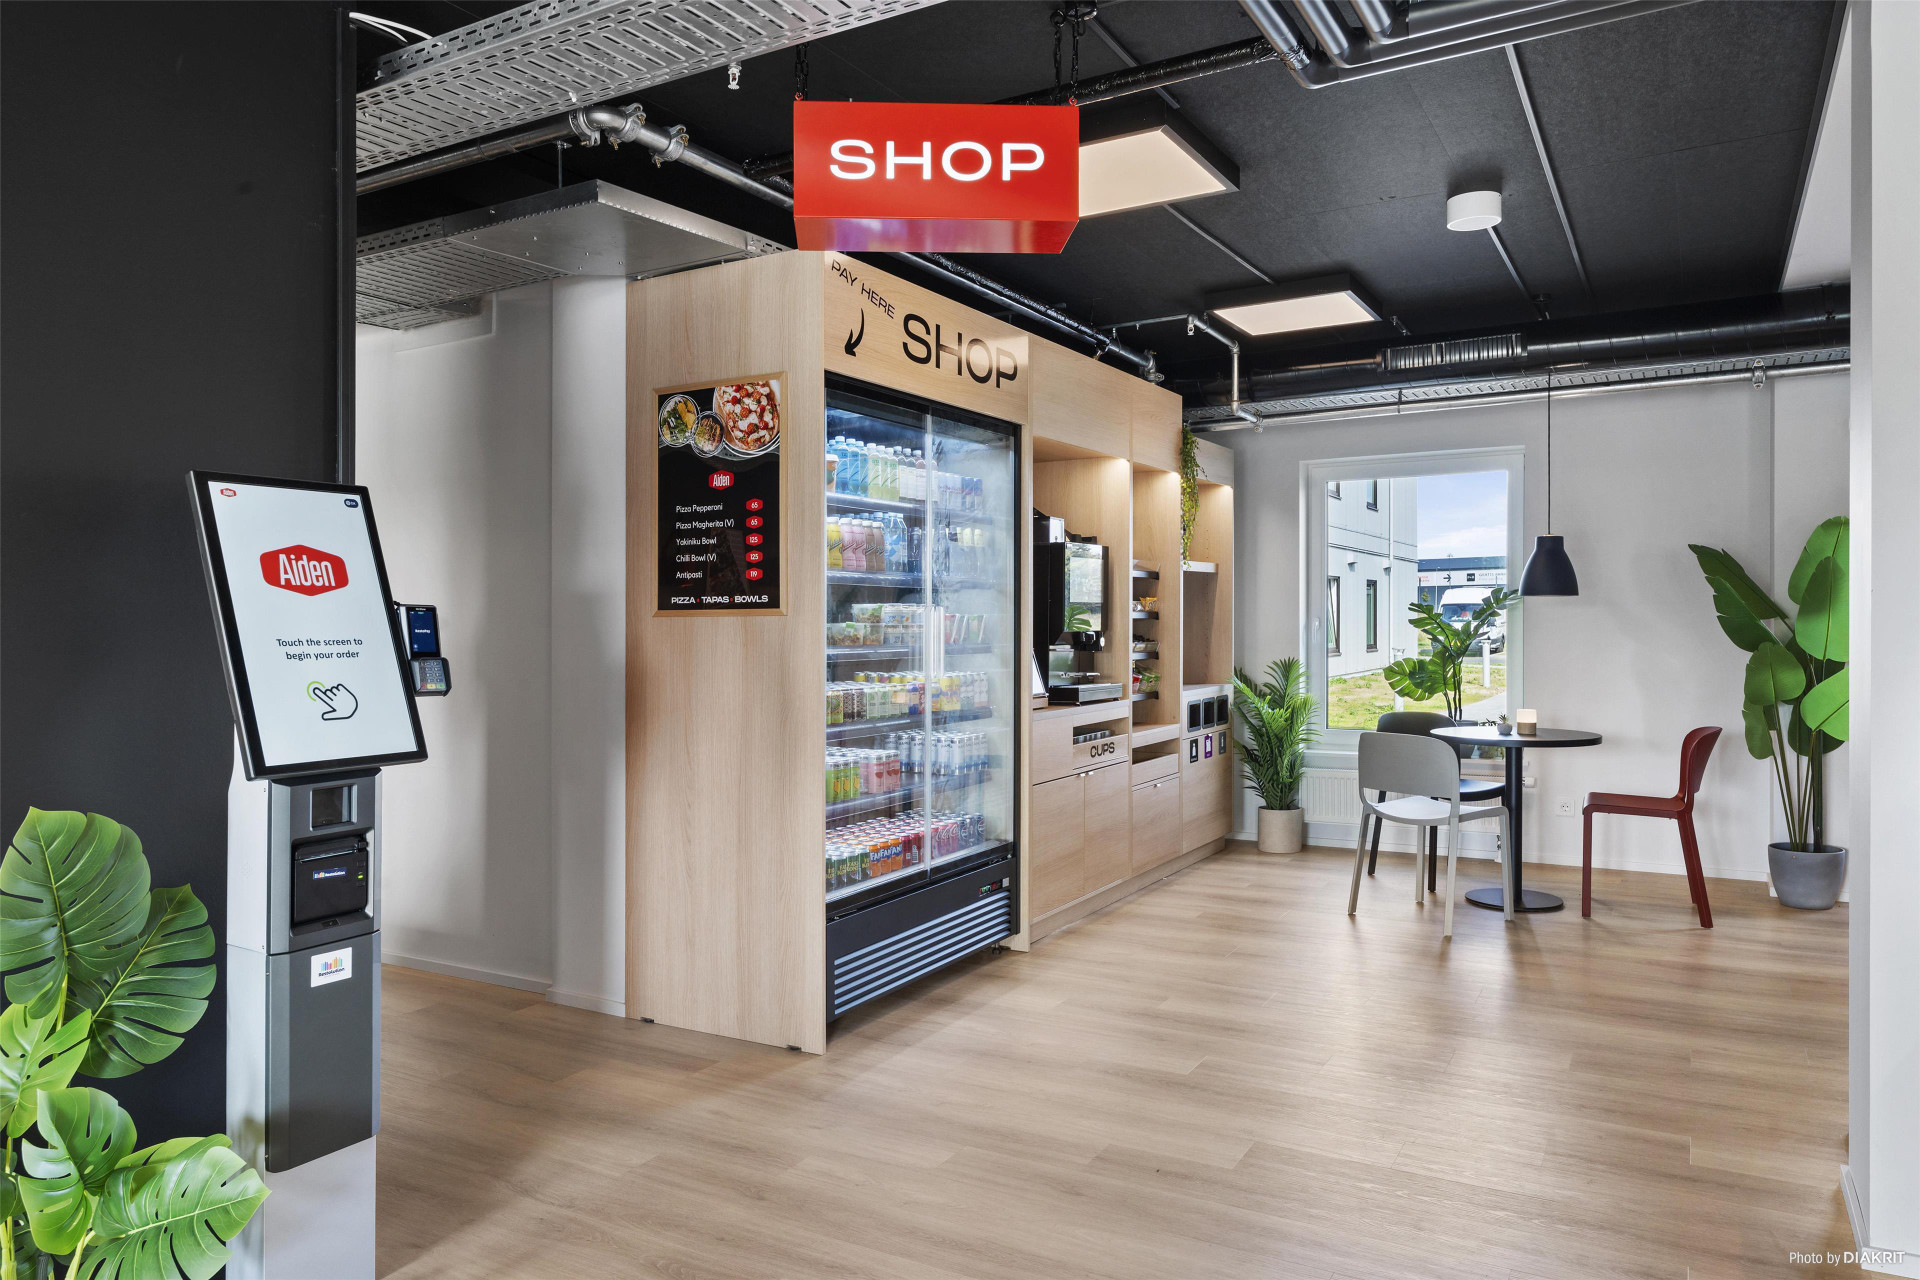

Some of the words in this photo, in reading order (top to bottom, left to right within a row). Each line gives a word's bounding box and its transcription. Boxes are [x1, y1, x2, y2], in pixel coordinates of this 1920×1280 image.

[829, 138, 1045, 182] SHOP
[831, 258, 858, 287] PAY
[861, 282, 896, 319] HERE
[902, 313, 1018, 389] SHOP
[713, 474, 730, 487] Aiden
[676, 505, 691, 513] Pizza
[692, 503, 723, 513] Pepperoni
[751, 501, 758, 509] 65
[676, 522, 691, 530] Pizza
[692, 519, 723, 530] Magherita
[724, 518, 735, 528] (V)
[676, 537, 700, 546] Yakiniku
[701, 536, 717, 545] Bowl
[676, 554, 690, 562] Chilli
[691, 553, 706, 562] Bowl
[706, 553, 717, 562] (V)
[278, 553, 336, 587] Aiden
[676, 570, 703, 580] Antipasti
[671, 596, 696, 604] PIZZA
[701, 595, 729, 603] TAPAS
[734, 594, 769, 603] BOWLS
[276, 638, 304, 647] Touch
[306, 638, 321, 646] the
[353, 638, 363, 646] to
[285, 651, 312, 661] begin
[313, 652, 334, 660] your
[336, 650, 360, 658] order
[1090, 741, 1115, 758] CUPS
